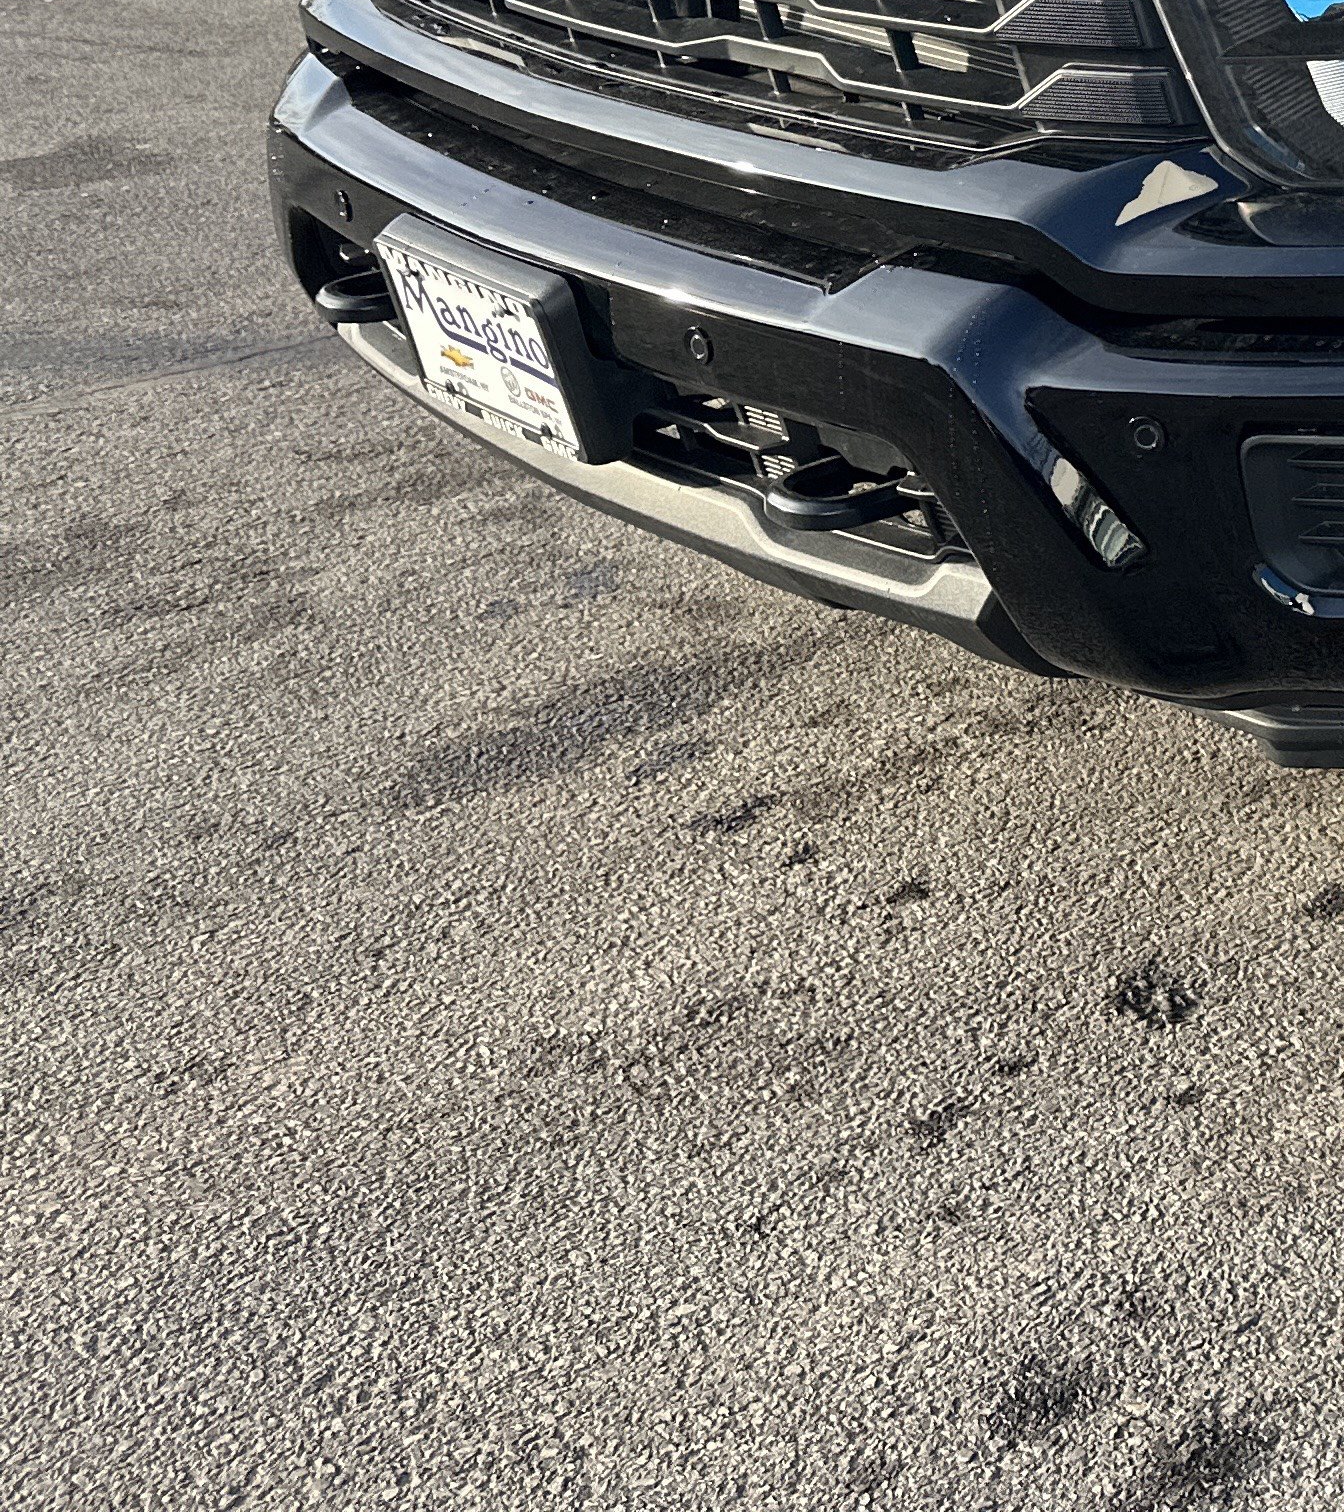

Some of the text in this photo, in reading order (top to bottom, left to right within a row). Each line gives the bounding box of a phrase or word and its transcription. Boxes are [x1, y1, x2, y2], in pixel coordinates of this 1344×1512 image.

[399, 269, 552, 370] Mangino
[524, 387, 559, 414] GMC
[481, 409, 526, 440] BUICK
[541, 434, 579, 462] GMC
